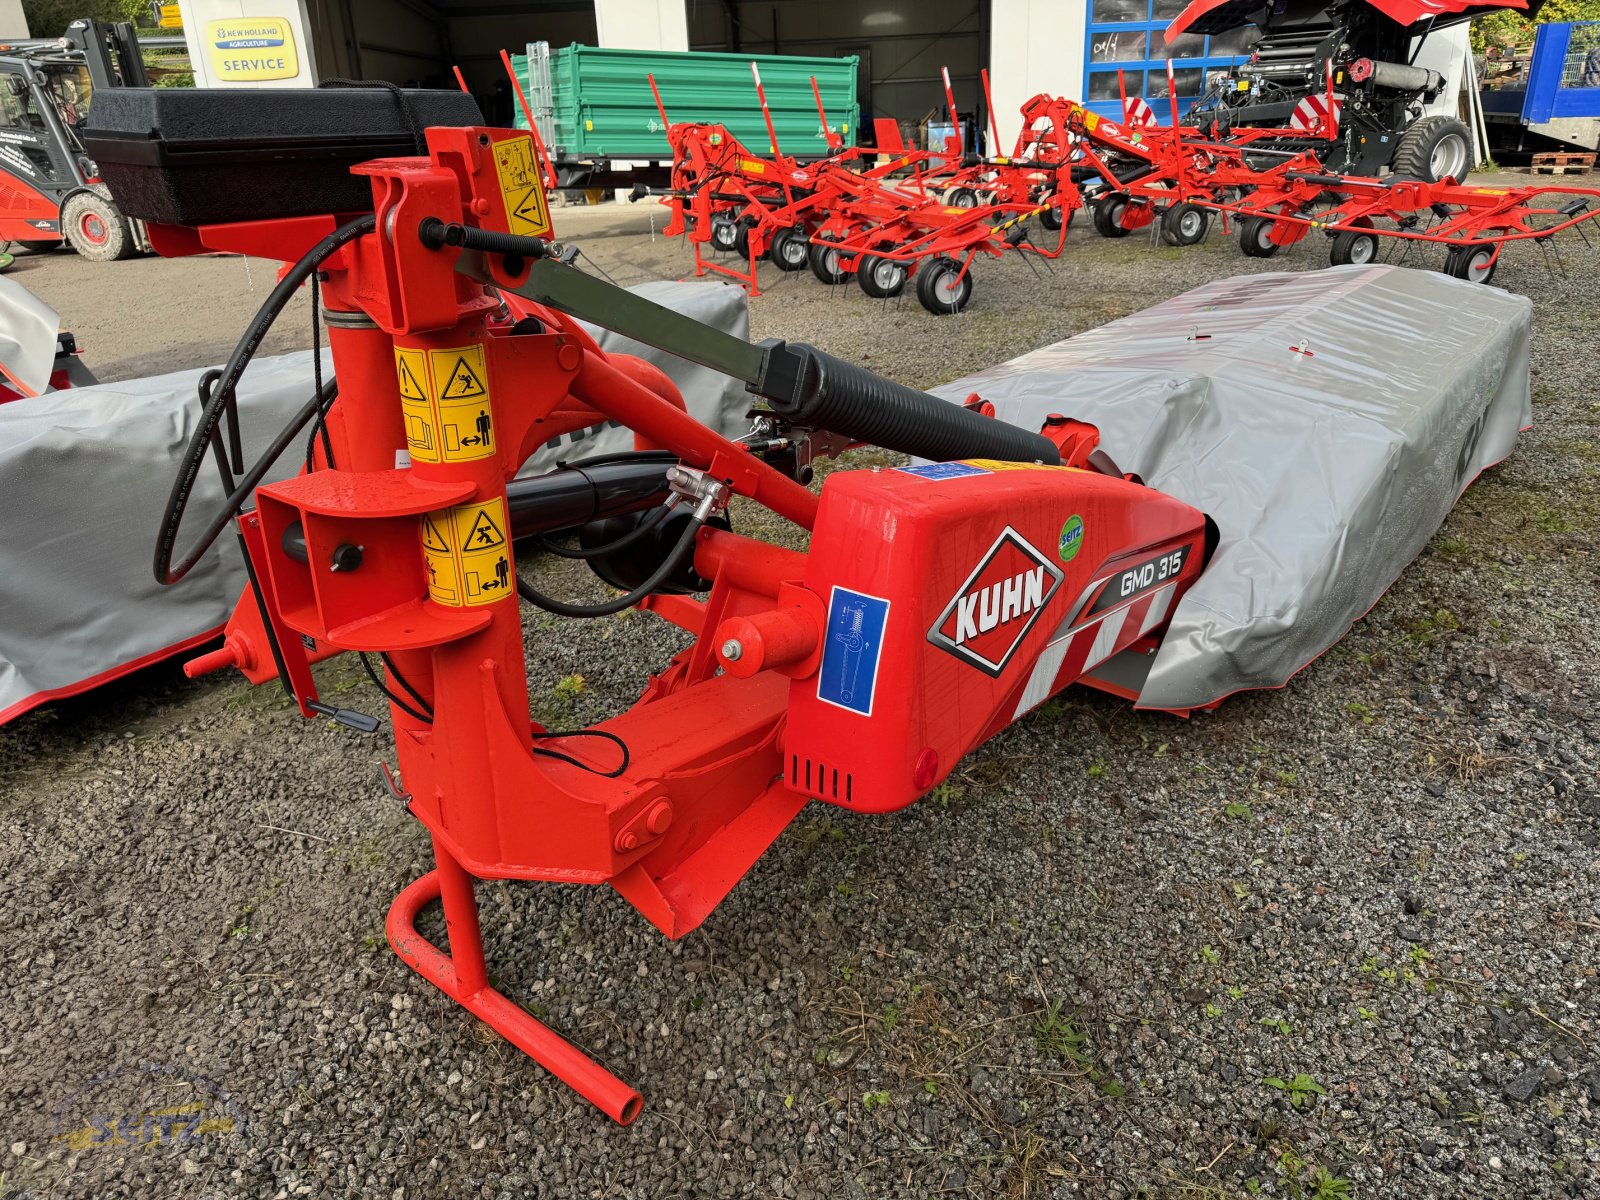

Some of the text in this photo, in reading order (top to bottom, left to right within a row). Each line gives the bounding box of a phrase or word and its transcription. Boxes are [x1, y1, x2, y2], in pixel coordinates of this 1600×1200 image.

[227, 28, 278, 37] NEW HOLLAND
[229, 39, 269, 48] AGRICULTURE
[224, 58, 286, 71] SERVICE
[1062, 525, 1081, 546] SEITZ
[1121, 551, 1182, 597] GMD 315
[955, 565, 1045, 646] KUHN
